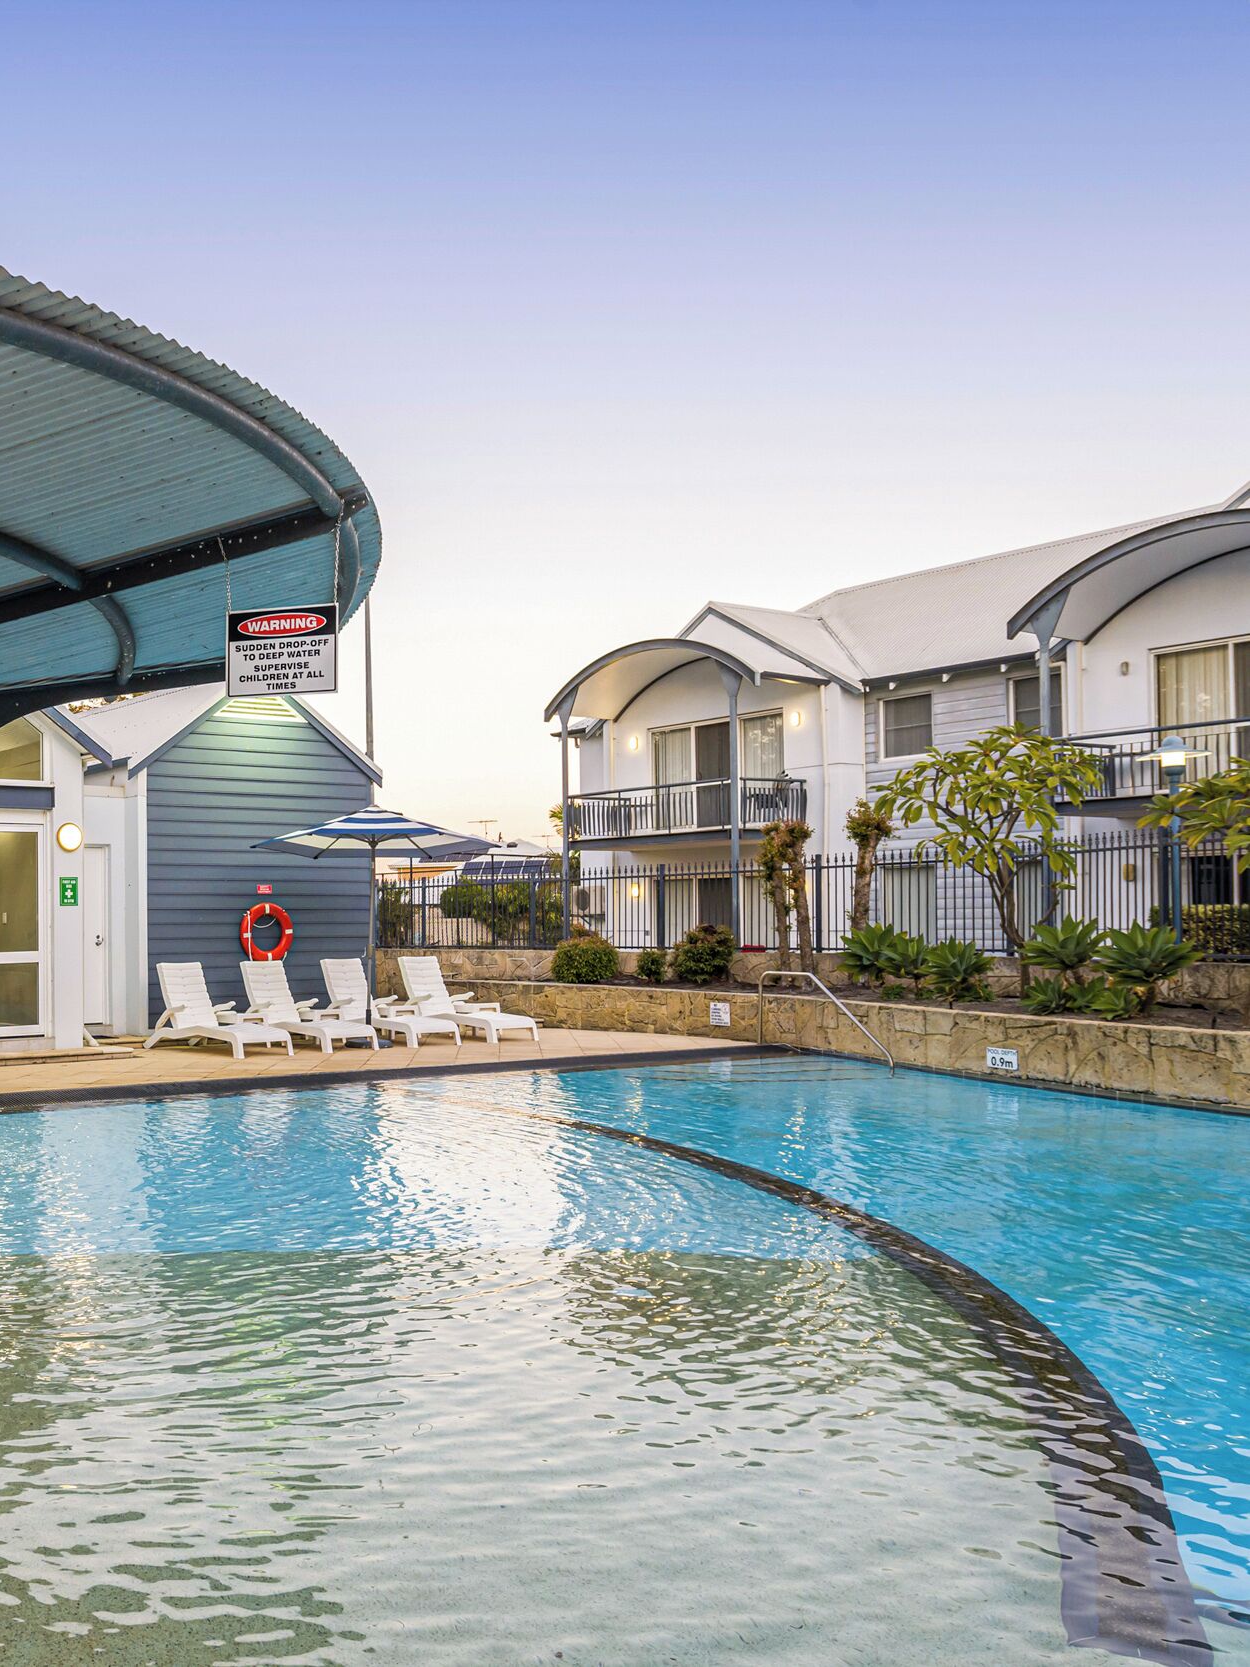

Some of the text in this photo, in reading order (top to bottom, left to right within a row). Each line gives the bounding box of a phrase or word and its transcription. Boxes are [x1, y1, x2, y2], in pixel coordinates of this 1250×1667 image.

[247, 617, 317, 633] WARNING
[235, 639, 329, 652] SUDDEN DROP-OFF
[259, 652, 284, 660] DEEP
[287, 649, 321, 658] WATER
[254, 662, 310, 672] SUPERVISE
[239, 673, 289, 683] CHILDREN
[266, 682, 297, 690] TIMES
[991, 1057, 1013, 1068] 0.9m
